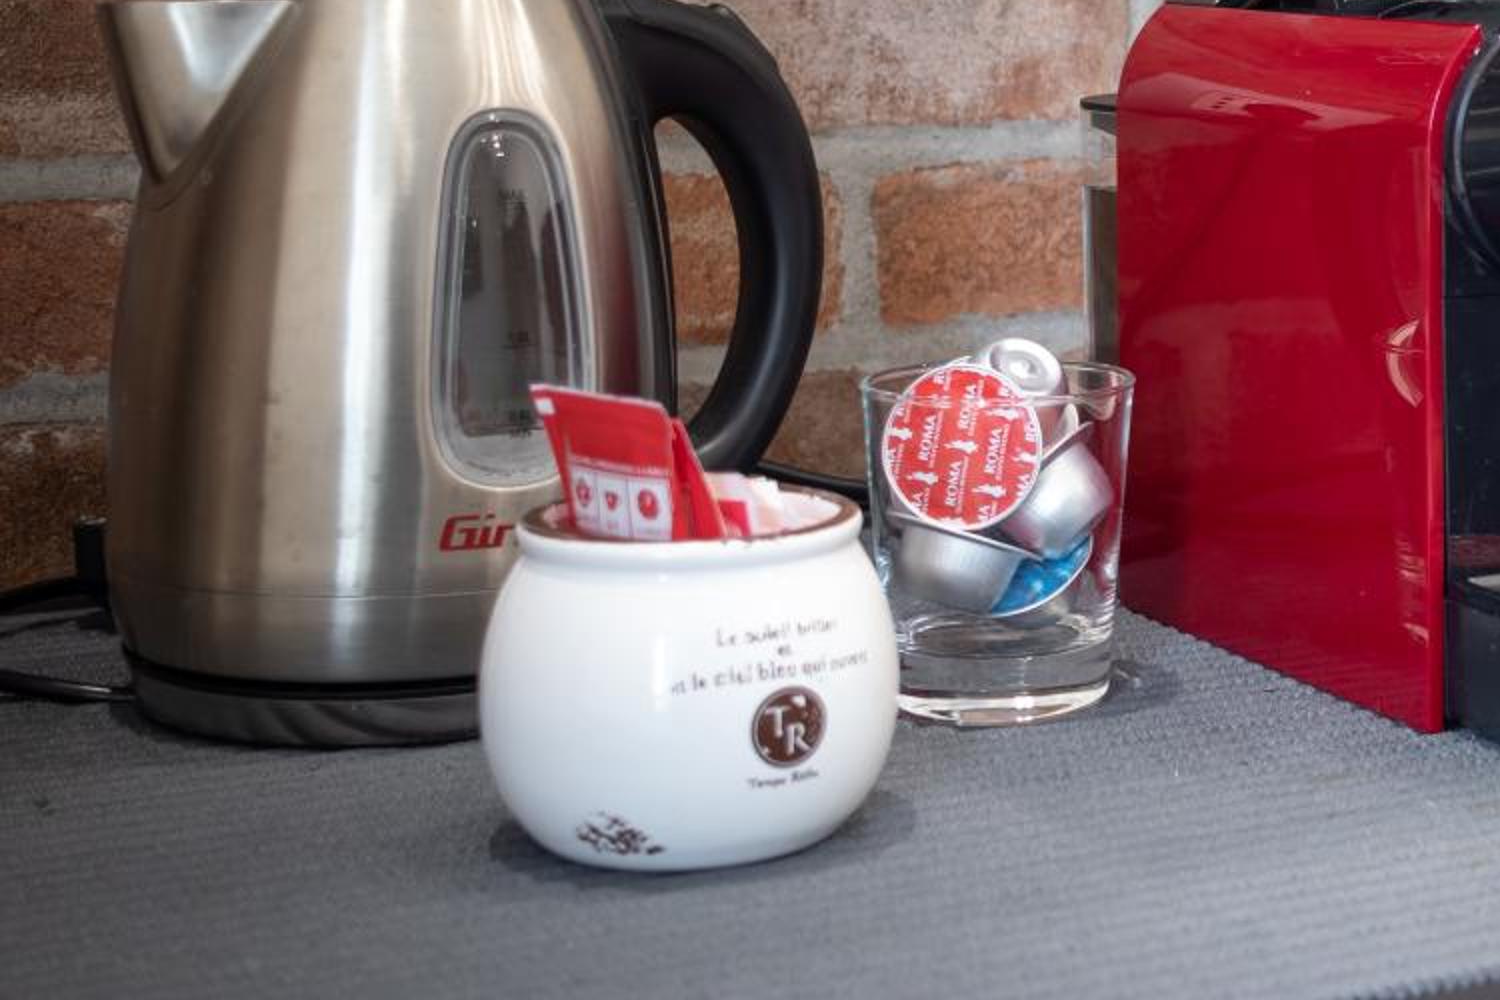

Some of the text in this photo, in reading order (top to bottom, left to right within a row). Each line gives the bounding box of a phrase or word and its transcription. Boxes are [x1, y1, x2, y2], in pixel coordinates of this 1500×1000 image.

[917, 414, 937, 461] ROMA
[983, 427, 1003, 474] ROMA
[945, 460, 962, 507] ROMA
[439, 512, 515, 552] Gir
